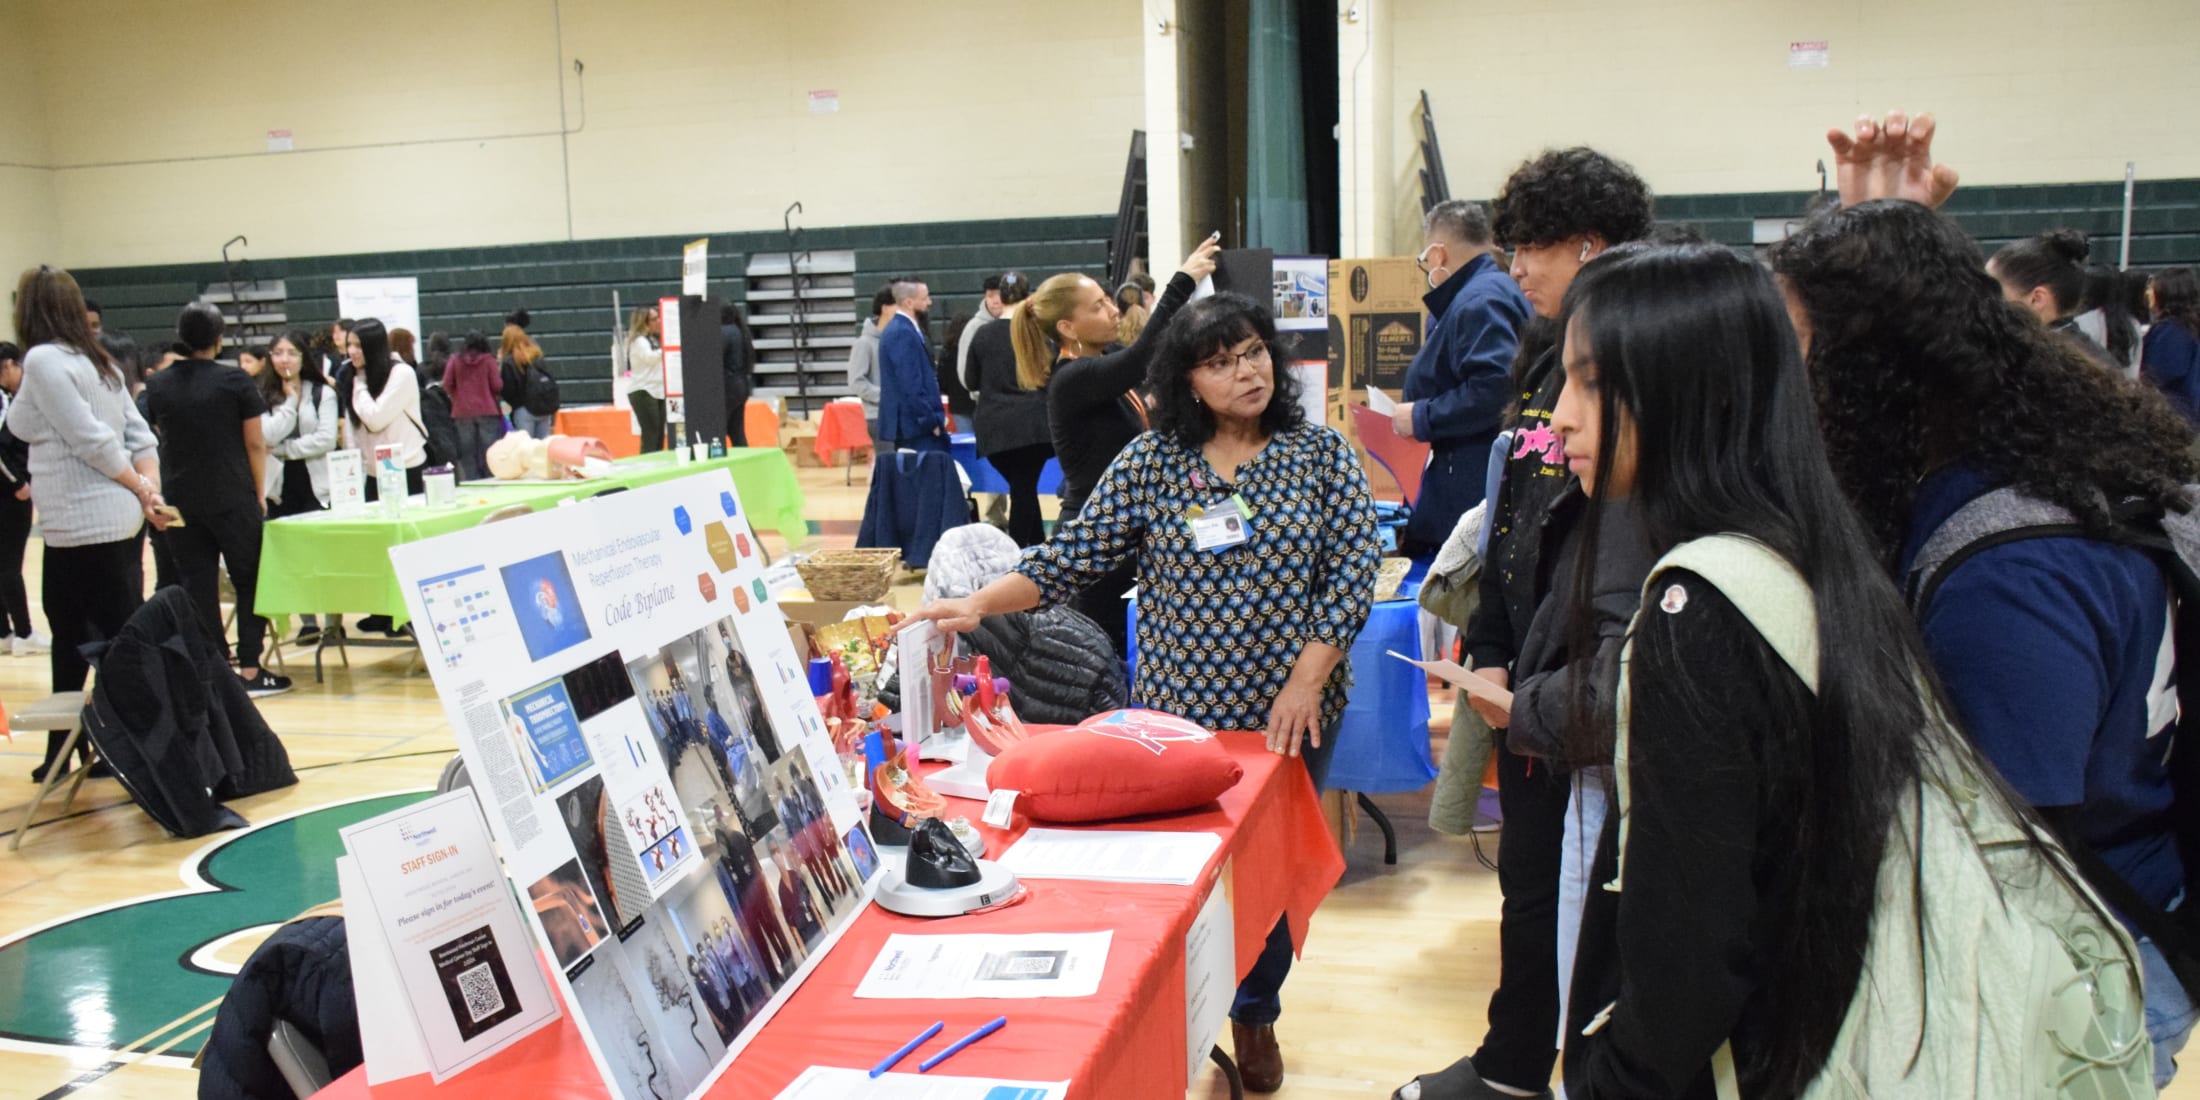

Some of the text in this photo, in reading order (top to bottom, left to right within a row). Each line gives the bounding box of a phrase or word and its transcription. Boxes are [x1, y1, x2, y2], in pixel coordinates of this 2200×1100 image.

[1379, 333, 1412, 343] ELMER'S
[571, 527, 662, 566] Mechanical Endovascular
[588, 551, 664, 588] Reperfusion Therapy
[604, 583, 677, 627] Code Biplane
[413, 826, 437, 840] Northwell
[401, 844, 459, 875] STAFF SIGN-IN
[398, 912, 422, 927] Please
[421, 905, 436, 918] sign
[435, 900, 443, 911] in
[441, 897, 454, 911] for
[454, 887, 477, 905] today's
[476, 879, 496, 894] event!
